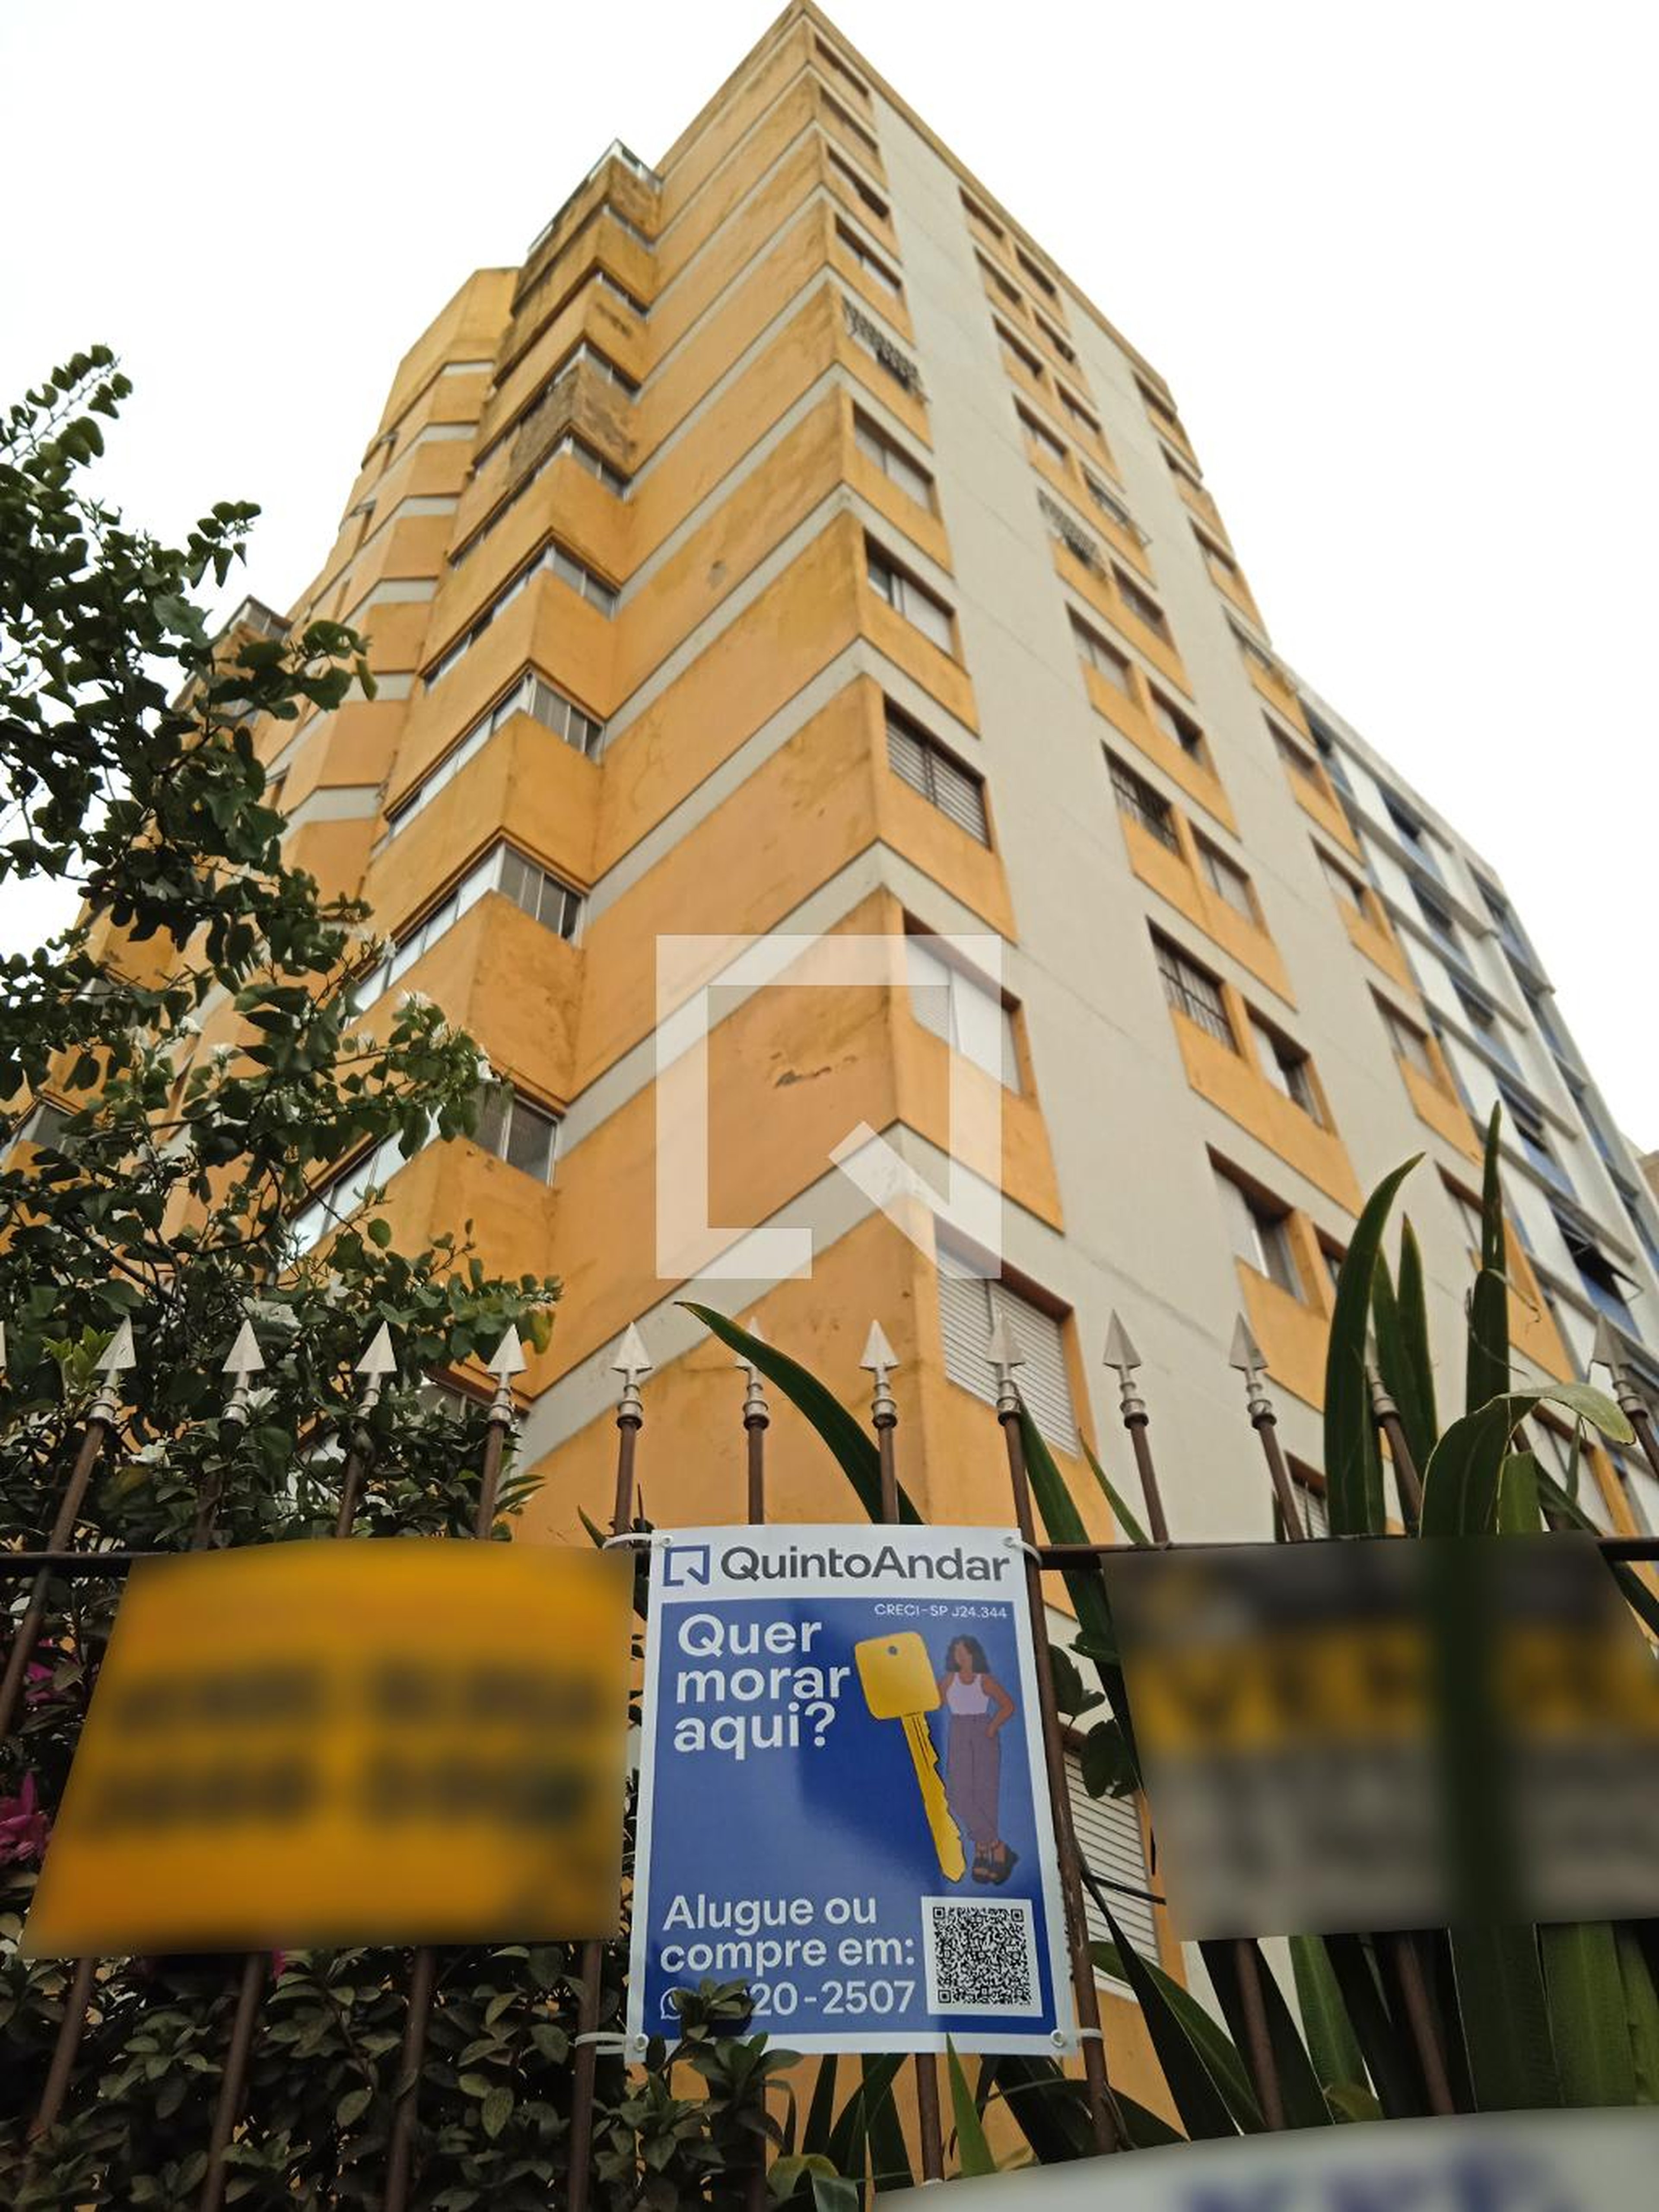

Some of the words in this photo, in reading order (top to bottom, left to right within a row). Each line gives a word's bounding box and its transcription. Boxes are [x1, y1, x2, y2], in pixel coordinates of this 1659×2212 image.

[721, 1546, 1010, 1581] QuintoAndar
[874, 1604, 948, 1617] CRECI-SP
[951, 1605, 1007, 1618] J24.344
[678, 1614, 822, 1657] Quer
[676, 1667, 850, 1703] morar
[673, 1701, 836, 1760] aqui?
[663, 1895, 814, 1936] Alugue
[824, 1897, 877, 1925] ou
[660, 1938, 826, 1976] compre
[838, 1938, 915, 1967] em:
